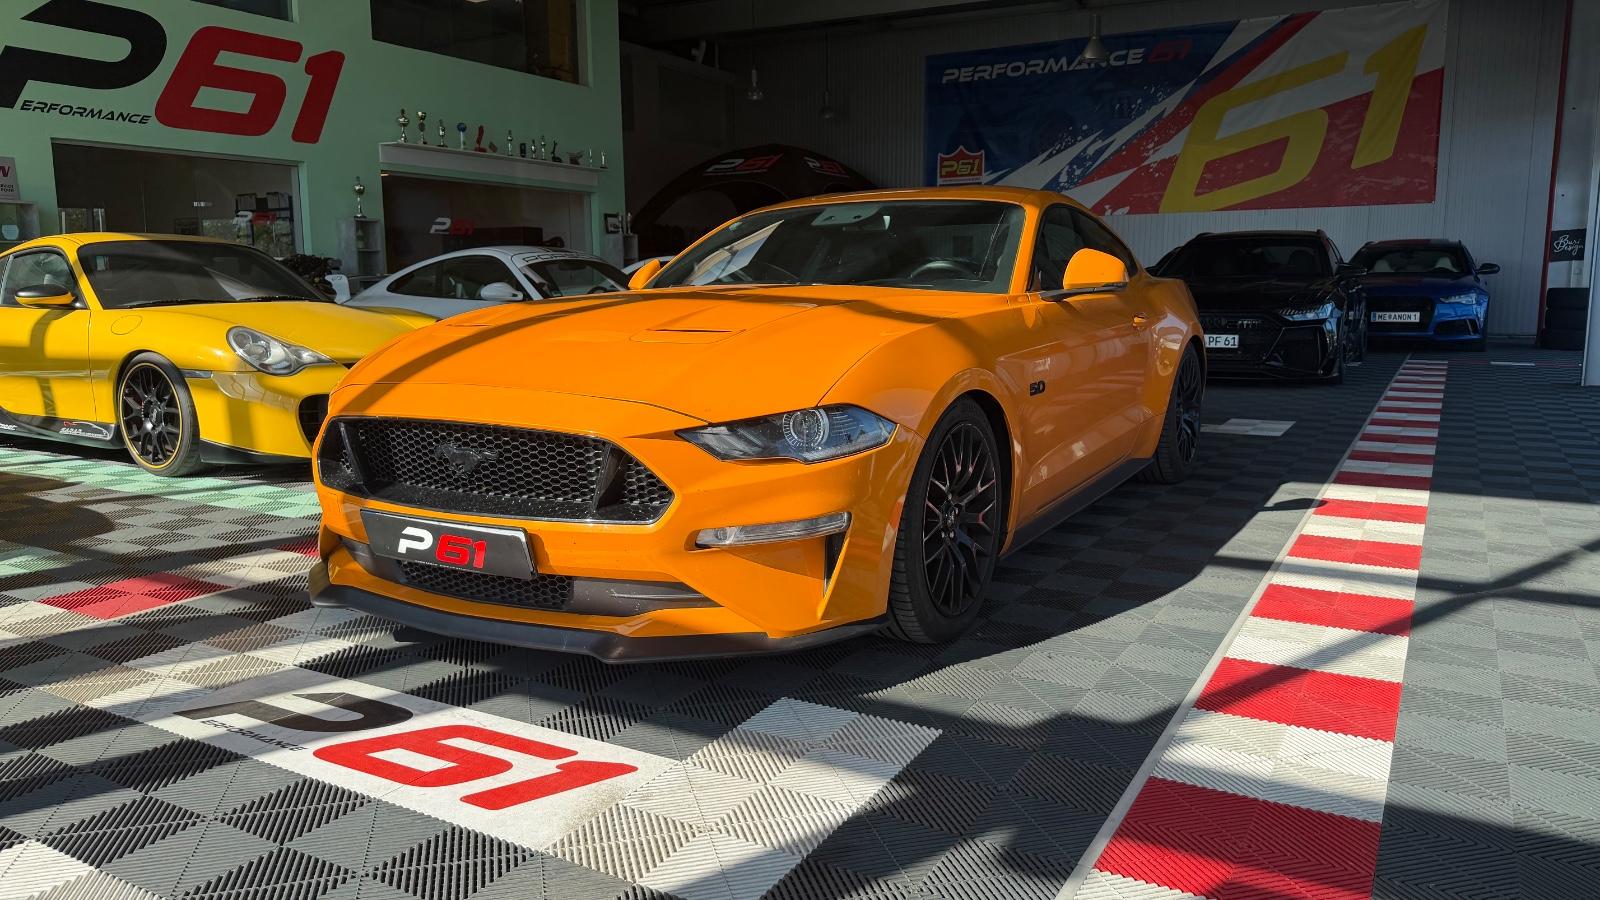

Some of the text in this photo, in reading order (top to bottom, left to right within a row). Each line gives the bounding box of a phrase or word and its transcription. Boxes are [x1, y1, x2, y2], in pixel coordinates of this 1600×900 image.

[20, 99, 152, 125] ERFORMANCE
[1159, 24, 1427, 213] 61
[941, 159, 981, 176] P61
[1208, 336, 1236, 346] PF 61
[397, 526, 487, 569] P61
[174, 691, 639, 810] P61
[200, 719, 308, 752] ERFORMANCE
